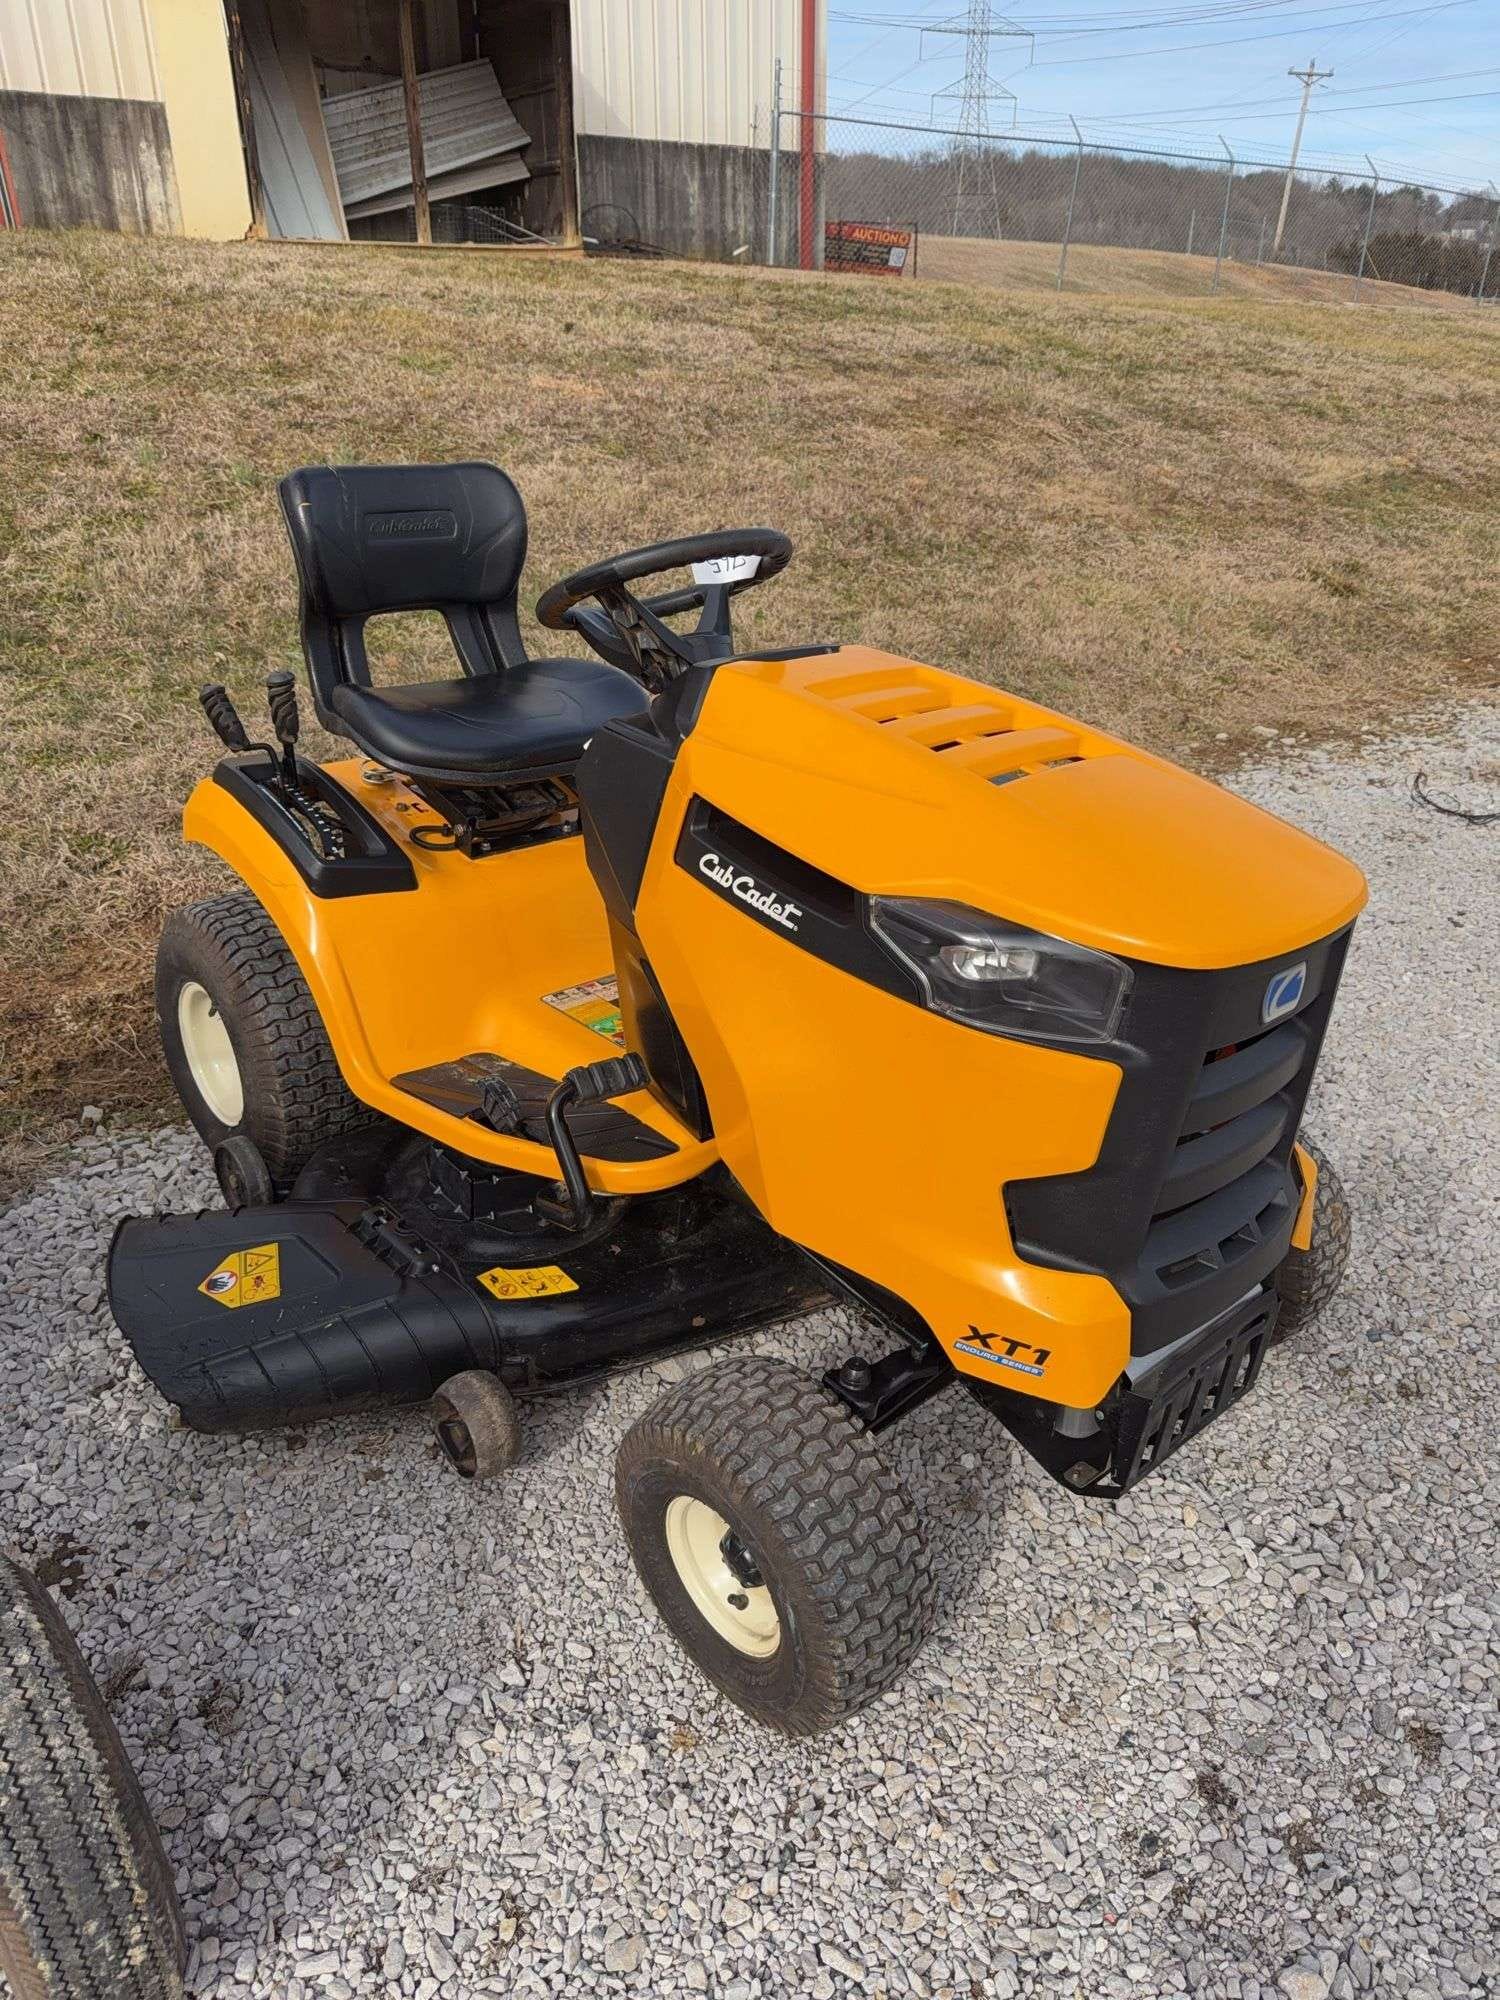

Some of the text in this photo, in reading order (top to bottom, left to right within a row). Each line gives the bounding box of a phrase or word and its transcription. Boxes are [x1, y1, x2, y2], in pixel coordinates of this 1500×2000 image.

[852, 226, 900, 244] AUCTION
[699, 853, 803, 930] Cub Cadet
[954, 1341, 1041, 1375] ENDURO SERIES
[958, 1324, 1053, 1366] XT1
